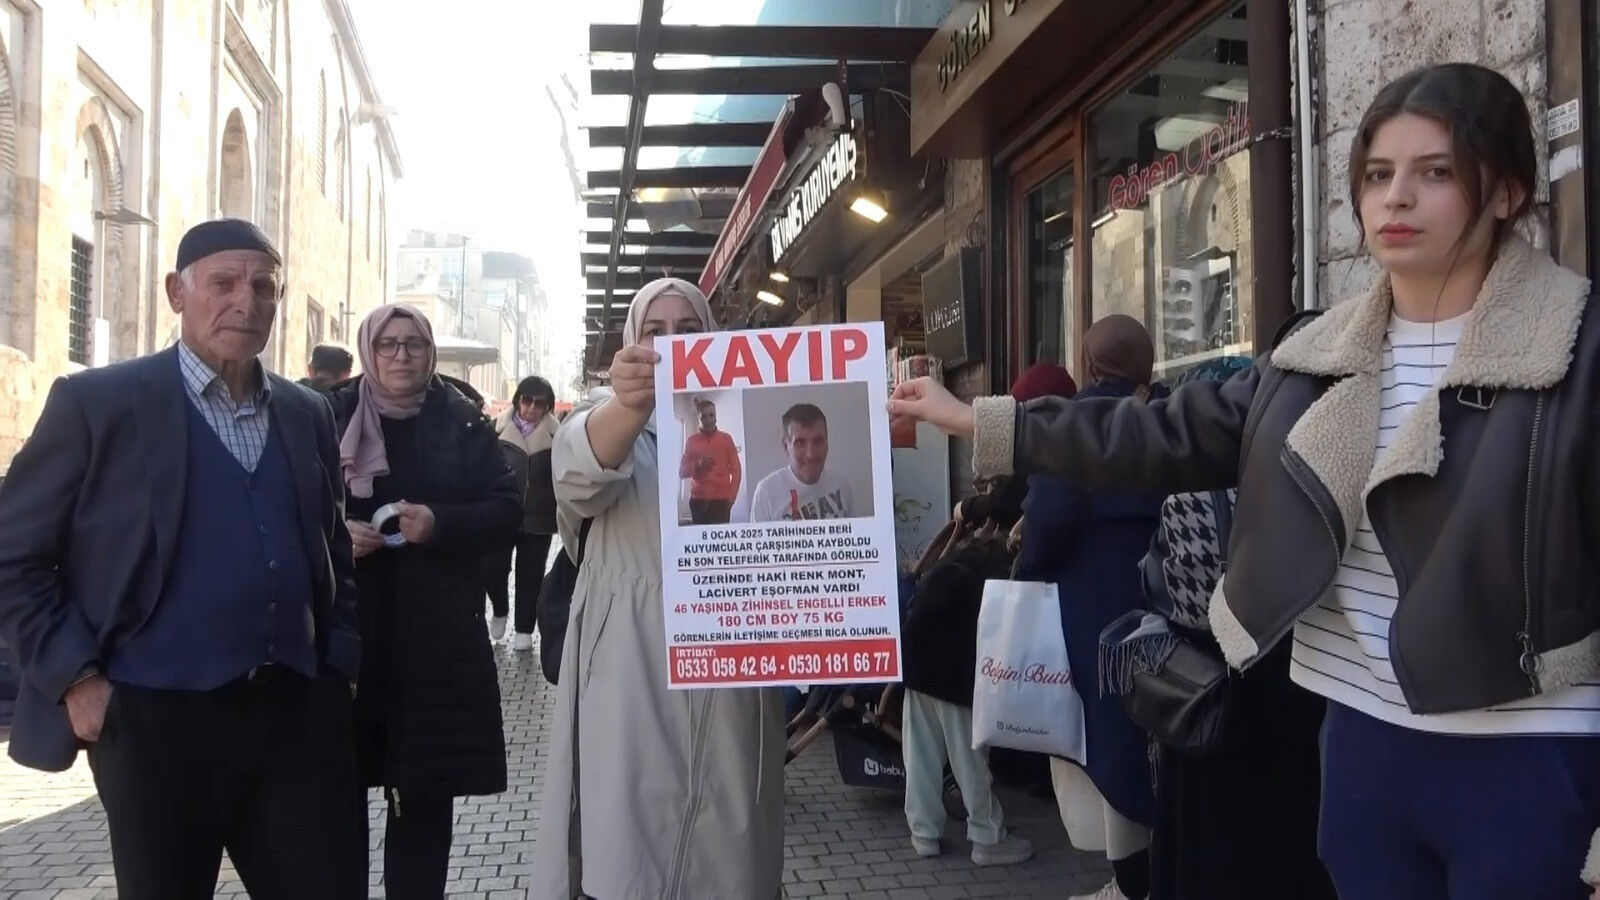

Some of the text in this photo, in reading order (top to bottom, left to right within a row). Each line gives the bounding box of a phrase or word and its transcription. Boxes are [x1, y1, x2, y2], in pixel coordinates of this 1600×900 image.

[937, 2, 991, 93] GÖREN
[1109, 100, 1251, 211] Gören Optik
[800, 118, 857, 225] KURUYEMİŞ
[672, 328, 868, 390] KAYIP
[702, 523, 852, 540] 8 OCAK 2025 TARİHİNDEN BERİ
[684, 537, 871, 554] KUYUMCULAR ÇARŞISINDA KAYBOLDU
[678, 548, 878, 567] EN SON TELEFERİK TARAFINDA GÖRÜLDÜ
[692, 569, 865, 585] ÜZERİNDE HAKİ RENK MONT,
[699, 583, 860, 598] LACİVERT EŞOFMAN VARDI
[674, 596, 886, 614] 46 YAŞINDA ZİHİNSEL ENGELLİ ERKEK
[717, 611, 844, 627] 180 CM BOY 75 KG
[674, 627, 890, 643] GÖRENLERİN İLETİŞİME GEÇMESİ RİCA OLUNUR.
[676, 648, 716, 658] İRTİBAT:
[677, 658, 708, 678] 0533
[712, 657, 736, 677] 058
[740, 656, 757, 676] 42
[760, 656, 777, 675] 64
[788, 654, 821, 674] 0530
[825, 652, 848, 673] 181
[853, 652, 870, 672] 66
[874, 652, 890, 671] 77
[981, 657, 1020, 685] Belgin
